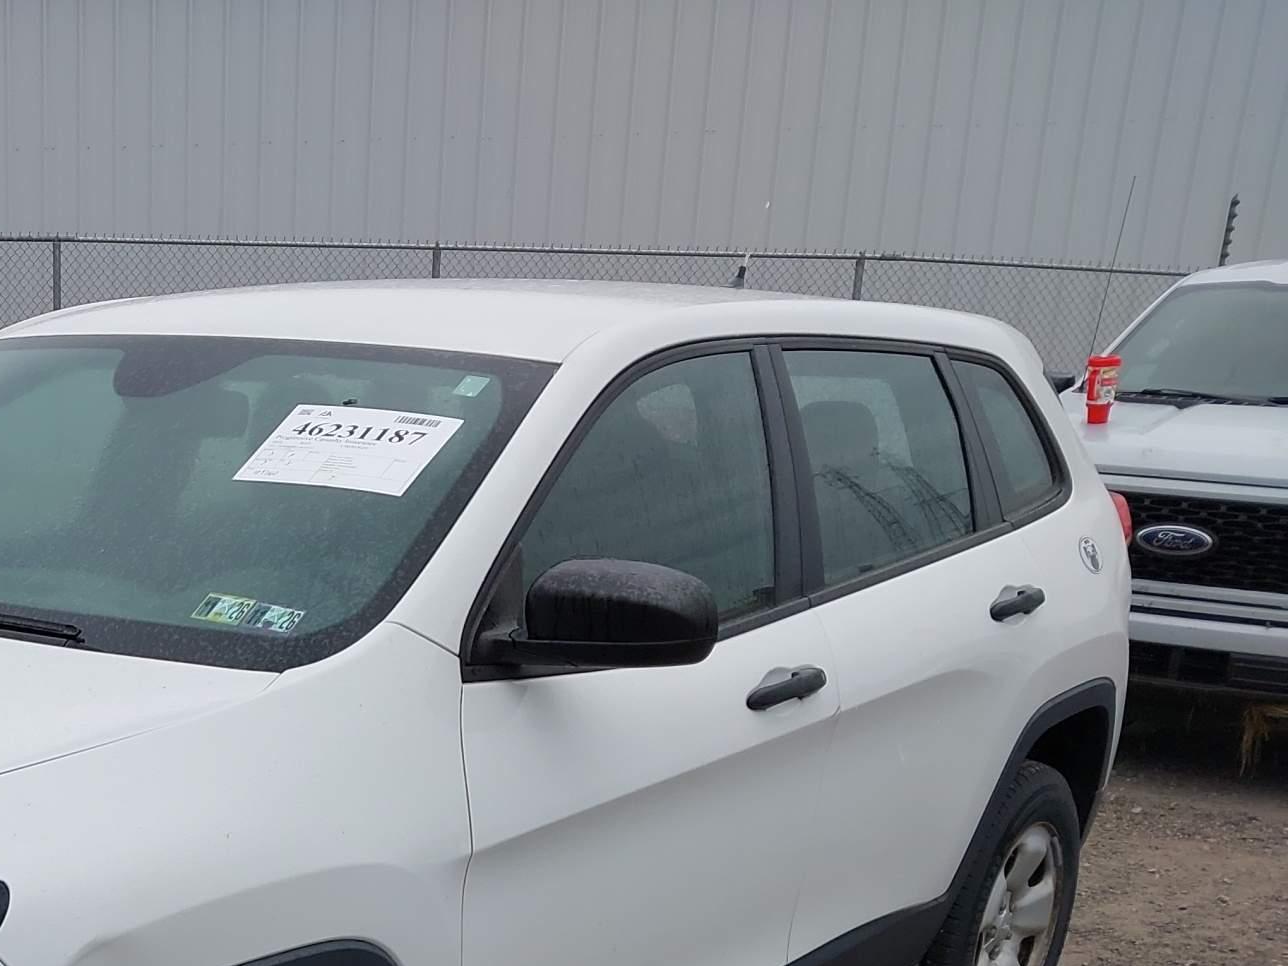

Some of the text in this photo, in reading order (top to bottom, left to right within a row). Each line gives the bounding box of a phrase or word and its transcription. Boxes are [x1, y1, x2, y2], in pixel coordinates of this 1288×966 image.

[291, 421, 428, 446] 46231187
[1152, 531, 1195, 549] Ford
[228, 601, 251, 621] 26
[278, 610, 301, 631] 26
